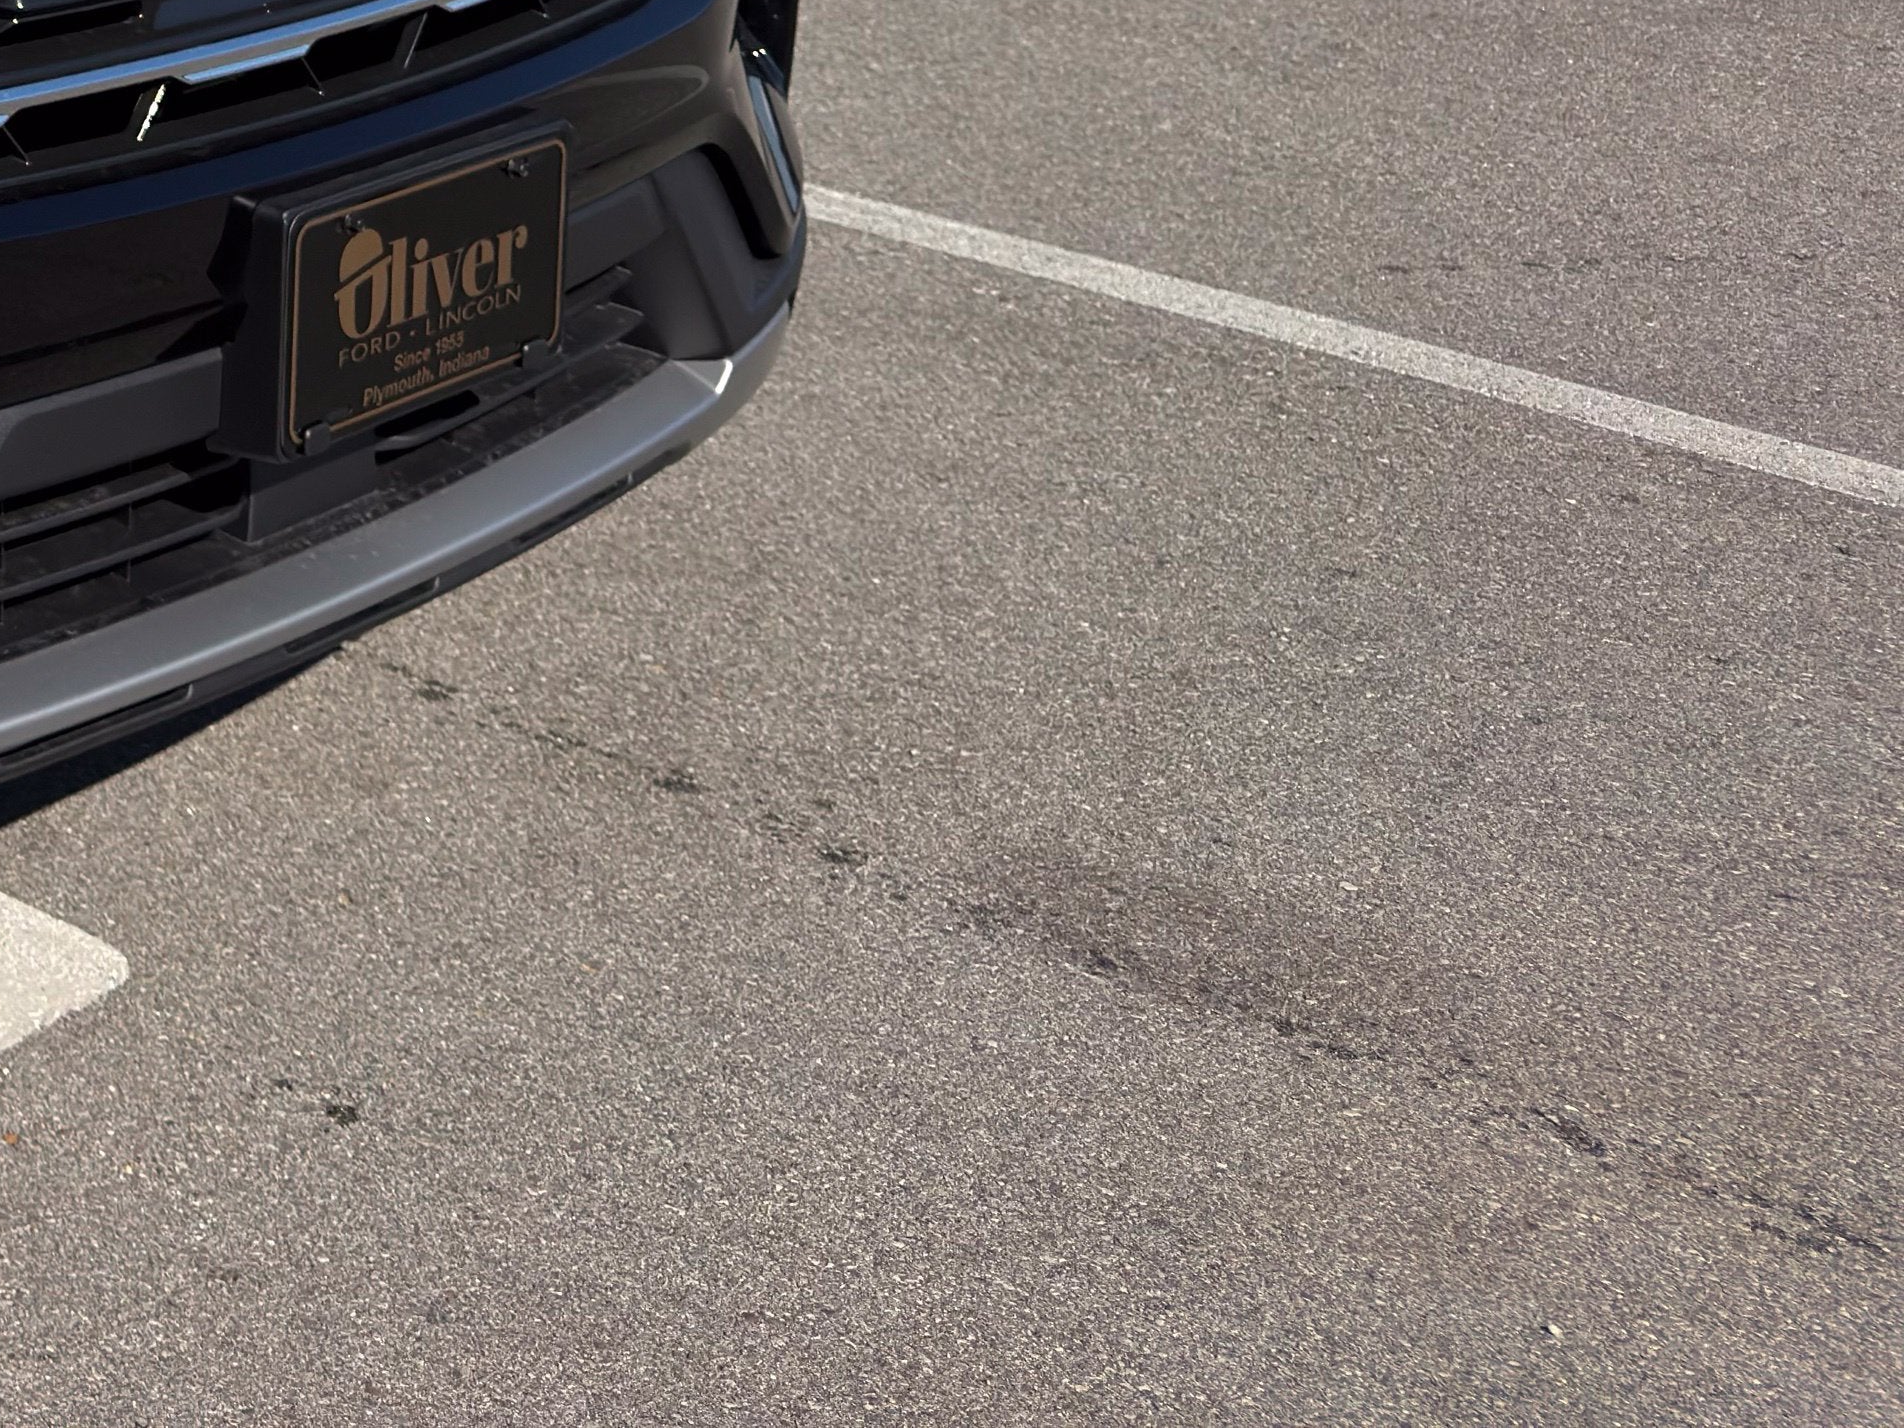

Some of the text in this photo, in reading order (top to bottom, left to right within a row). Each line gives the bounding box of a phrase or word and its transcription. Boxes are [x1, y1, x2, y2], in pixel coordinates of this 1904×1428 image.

[334, 225, 528, 339] Oliver
[338, 285, 521, 367] FORD LINCOLN
[394, 347, 431, 372] Since
[439, 346, 490, 377] Indiana
